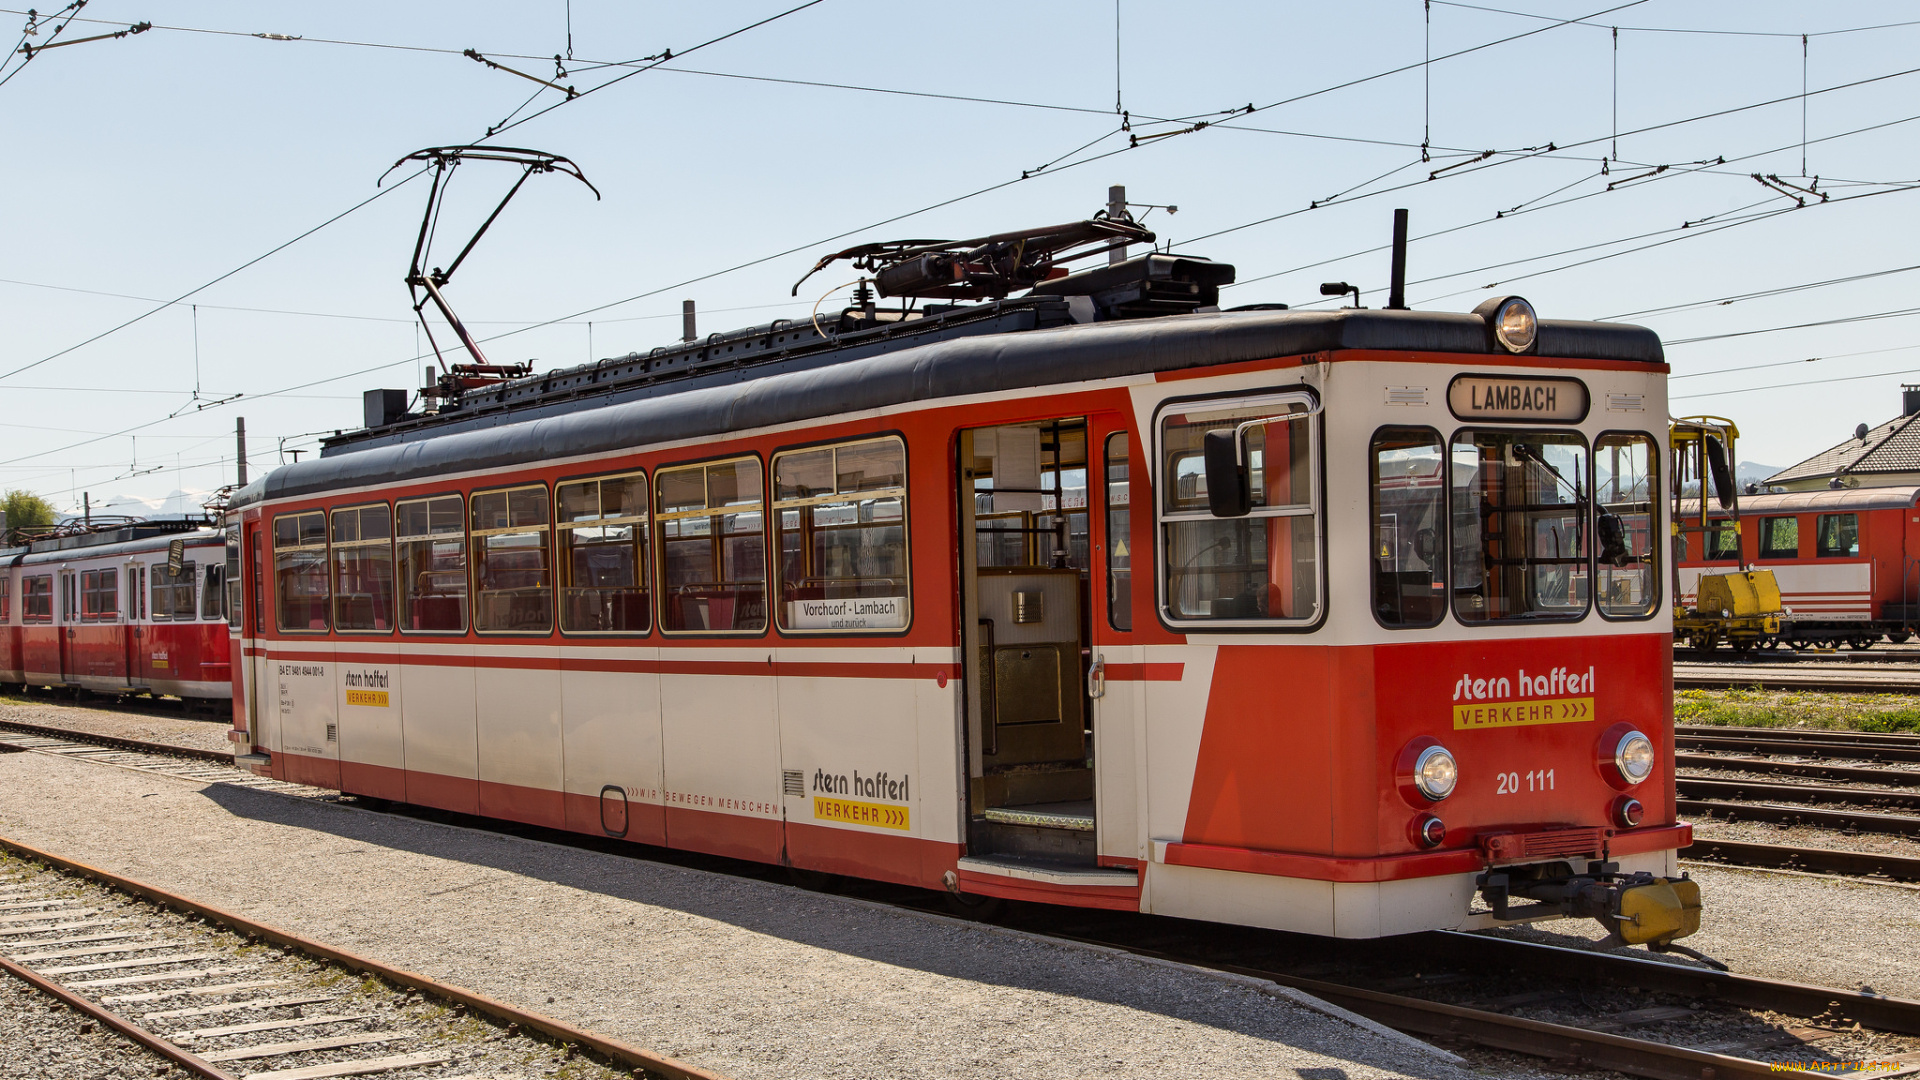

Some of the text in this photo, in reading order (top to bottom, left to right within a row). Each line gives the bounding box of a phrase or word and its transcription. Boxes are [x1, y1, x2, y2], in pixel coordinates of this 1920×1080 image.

[1471, 385, 1556, 411] LAMBACH
[854, 600, 895, 615] Lambach
[831, 618, 866, 628] und zurück
[346, 669, 389, 688] stern hafferl
[1453, 665, 1594, 700] stern hafferl
[348, 692, 377, 705] VERKEHR
[1461, 705, 1553, 725] VERKEHR
[813, 768, 909, 801] stern hafferl
[1496, 769, 1555, 795] 20 111
[640, 788, 778, 815] WIR BEWEGEN MENSCHEN
[818, 801, 879, 822] VERKEHR
